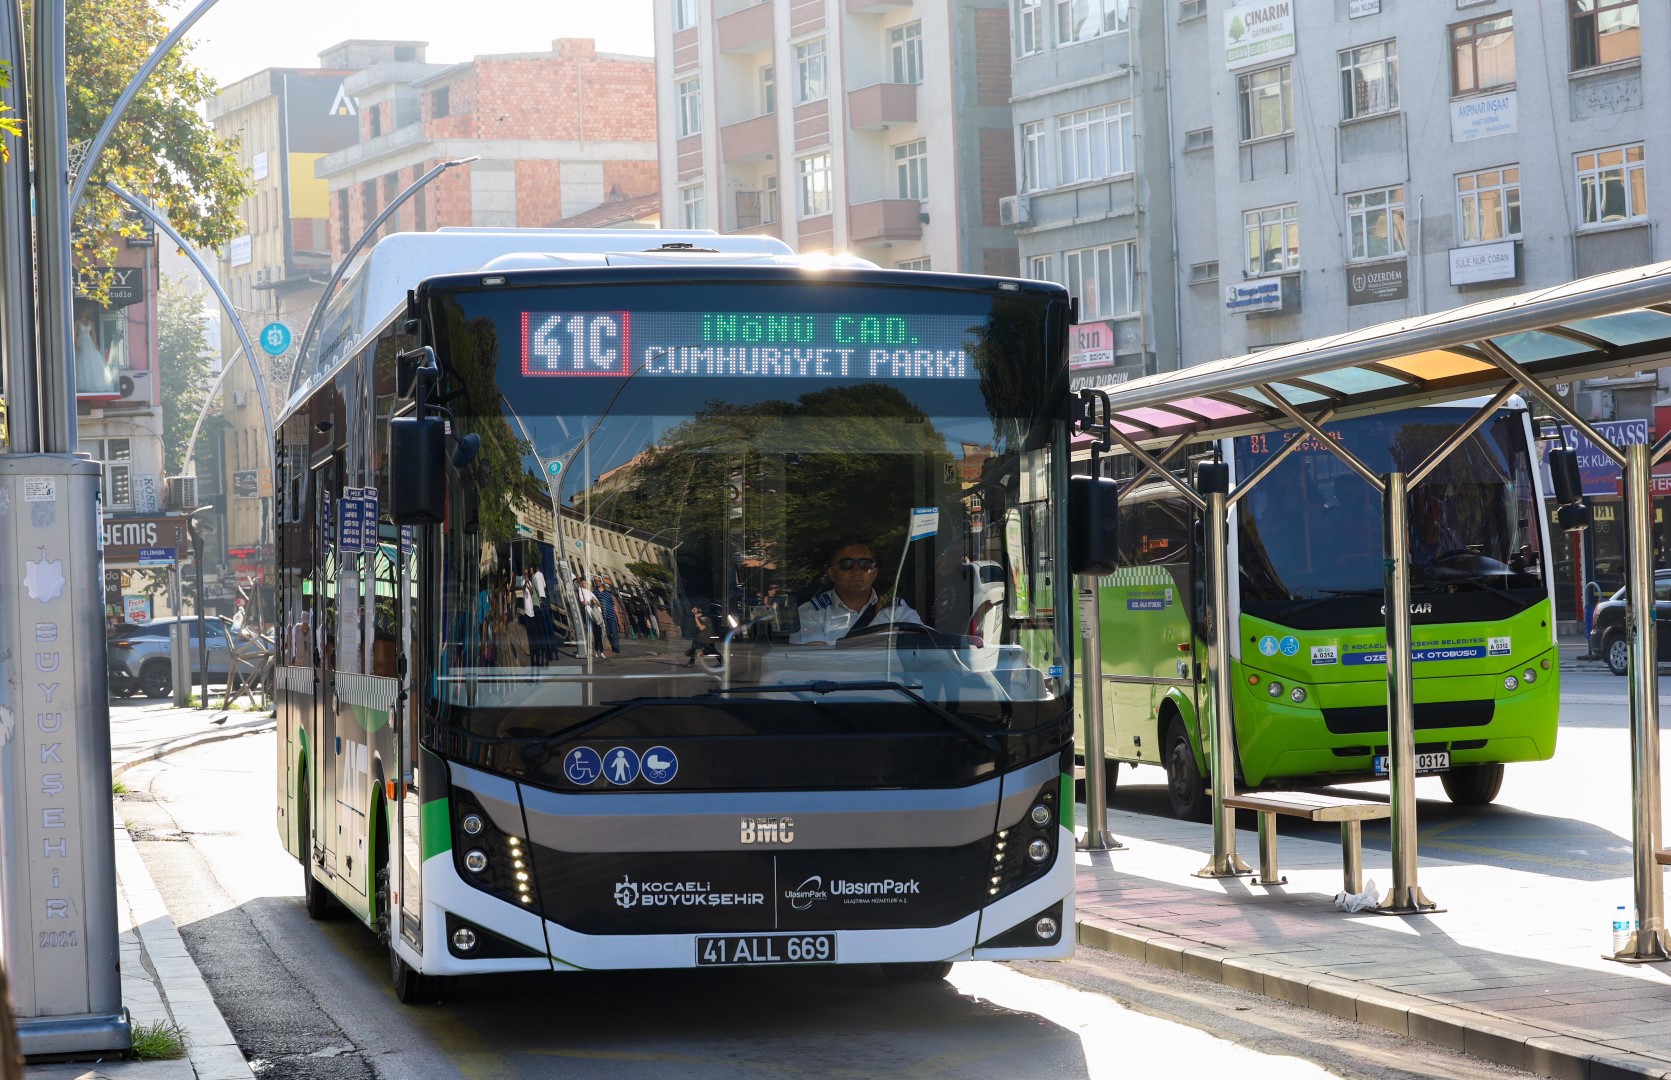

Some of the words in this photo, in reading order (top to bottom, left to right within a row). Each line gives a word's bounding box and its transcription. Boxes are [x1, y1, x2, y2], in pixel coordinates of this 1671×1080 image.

[1245, 2, 1289, 31] ÇINARIM
[1367, 270, 1402, 283] ÖZERDEM
[834, 316, 919, 344] CAD.
[533, 315, 617, 369] 41C
[869, 348, 966, 377] PARKI
[1096, 372, 1129, 387] DURGUN
[1250, 434, 1269, 453] 81
[1576, 455, 1590, 468] EK
[1592, 455, 1615, 468] KUA
[1383, 757, 1390, 770] 4
[1419, 754, 1446, 768] 0312
[740, 817, 795, 844] BMC
[39, 931, 78, 948] 2021
[703, 939, 726, 963] 41
[733, 937, 780, 962] ALL
[787, 936, 829, 960] 669
